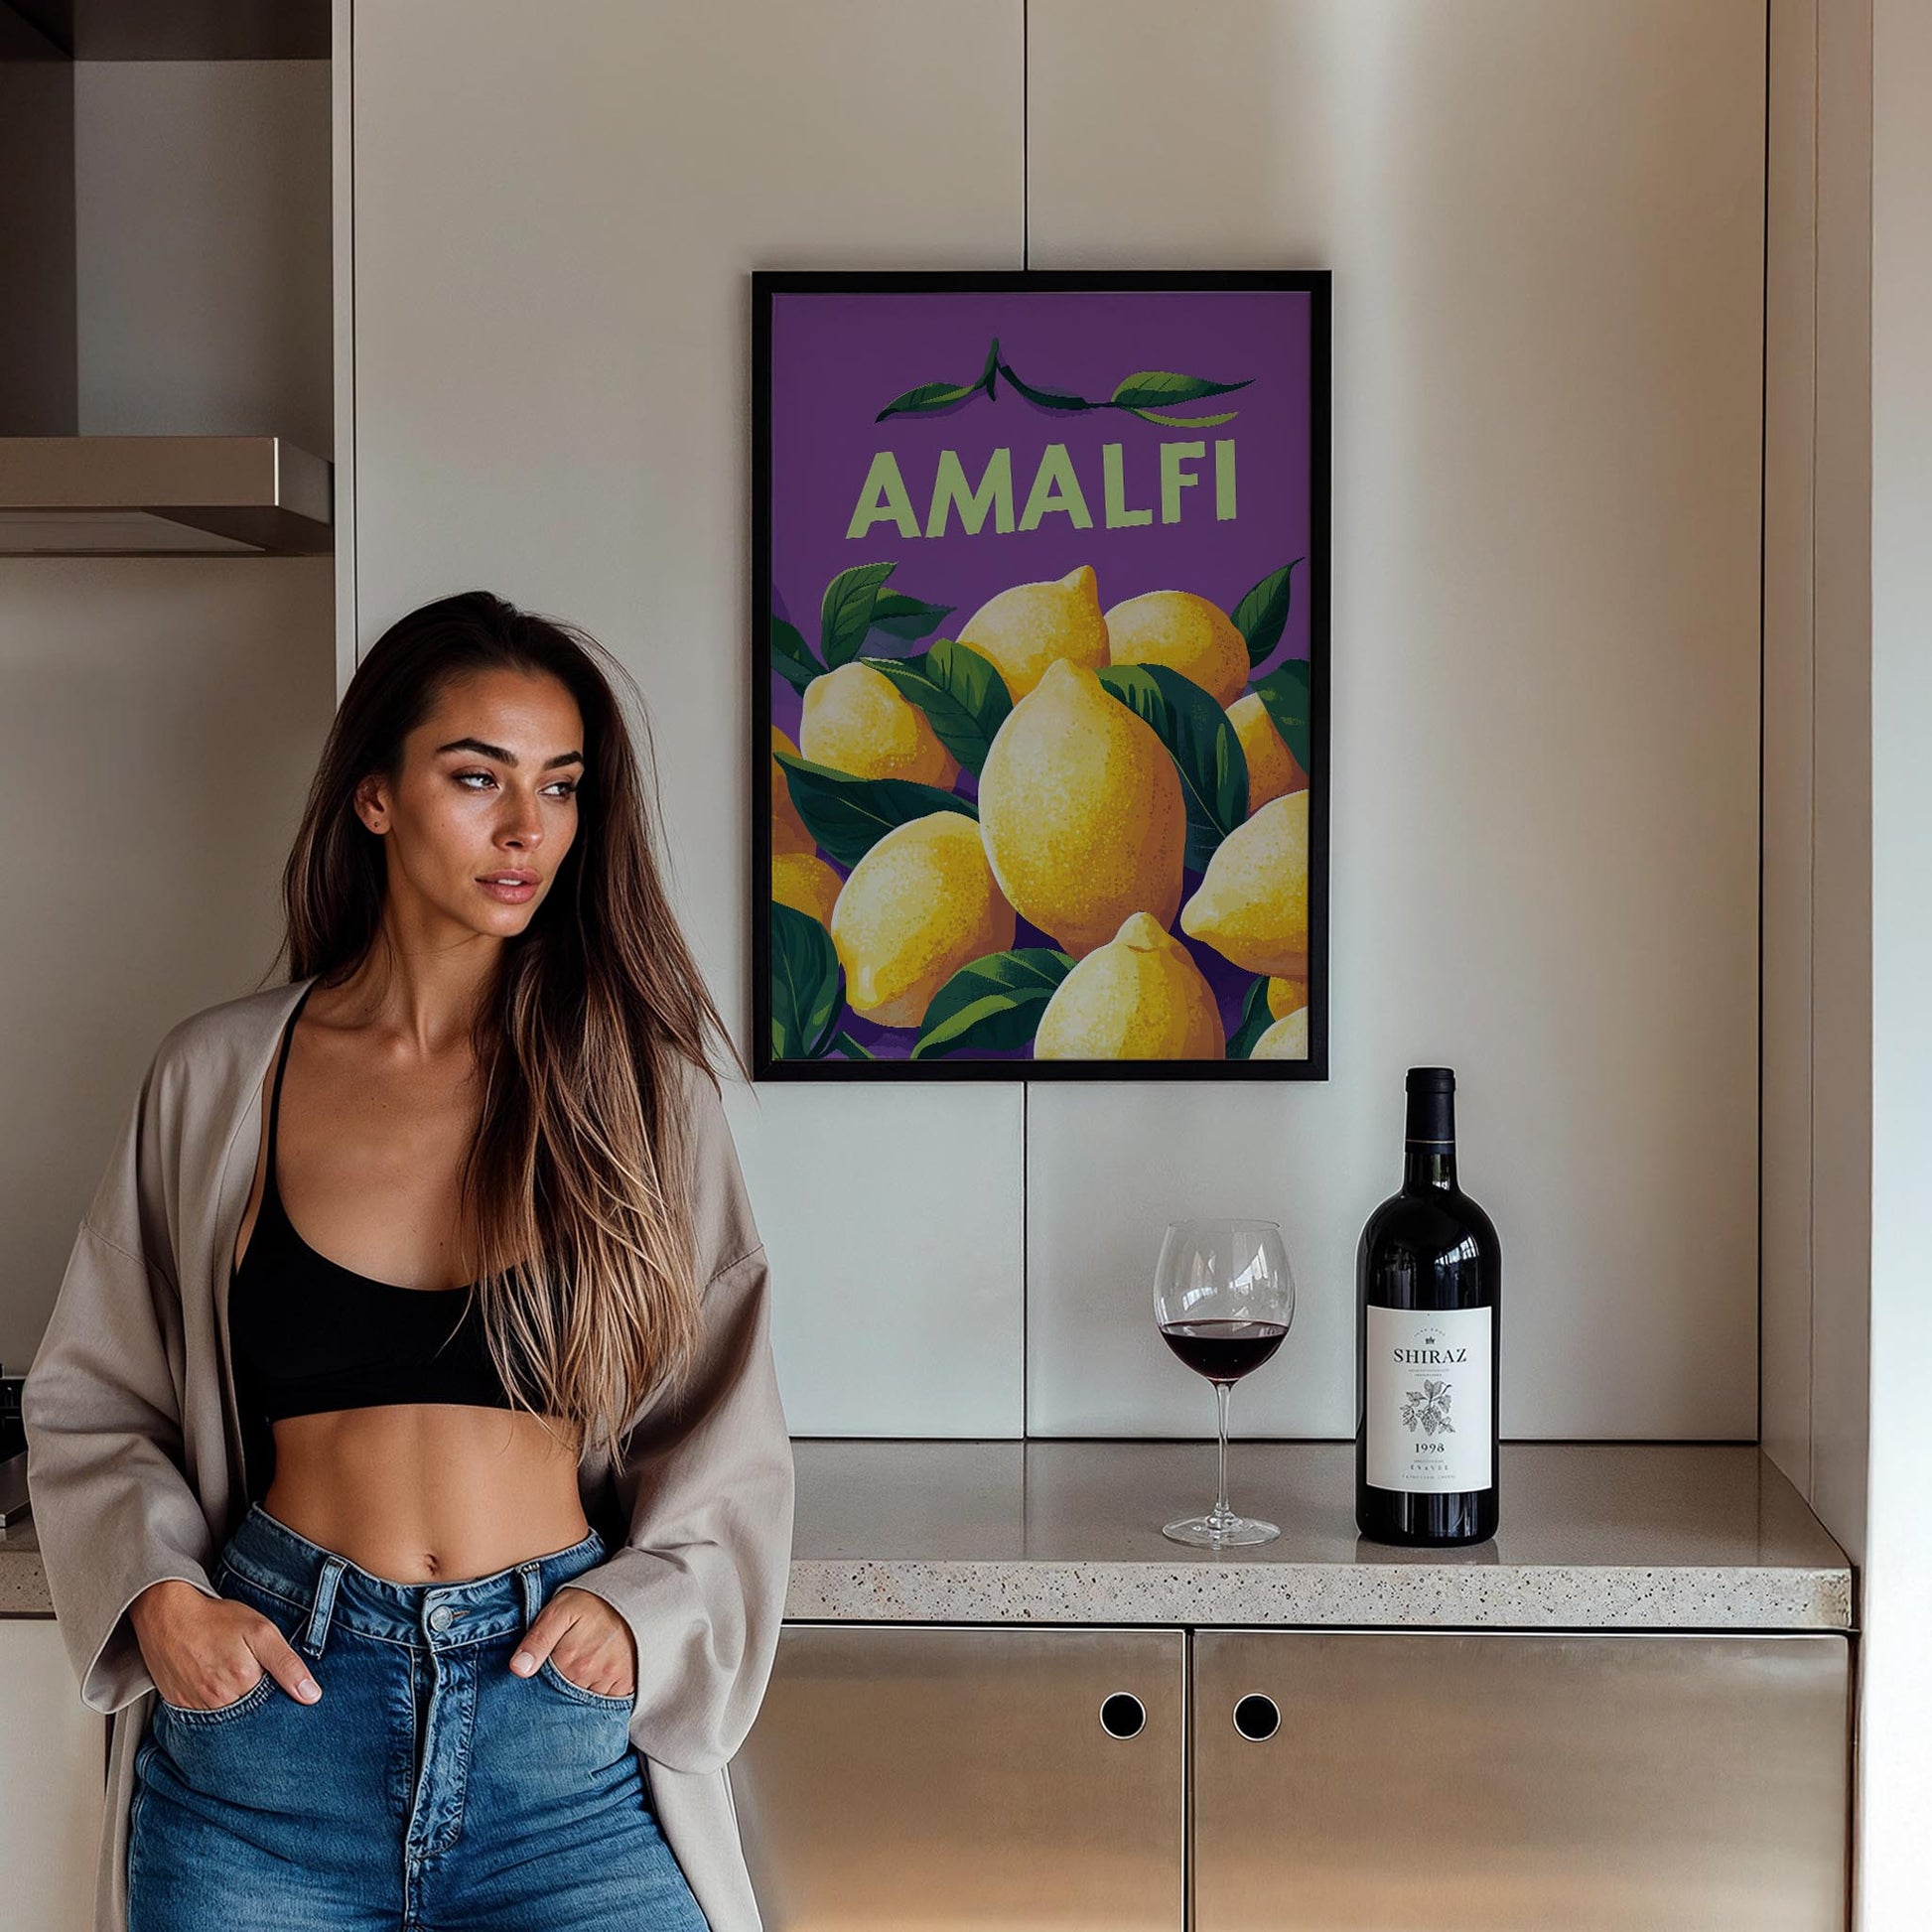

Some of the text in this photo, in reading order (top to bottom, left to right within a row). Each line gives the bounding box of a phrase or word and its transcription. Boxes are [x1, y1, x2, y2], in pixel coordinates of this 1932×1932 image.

[846, 439, 1237, 540] AMALFI
[1393, 1348, 1467, 1364] SHIRAZ
[1415, 1443, 1446, 1454] 1998
